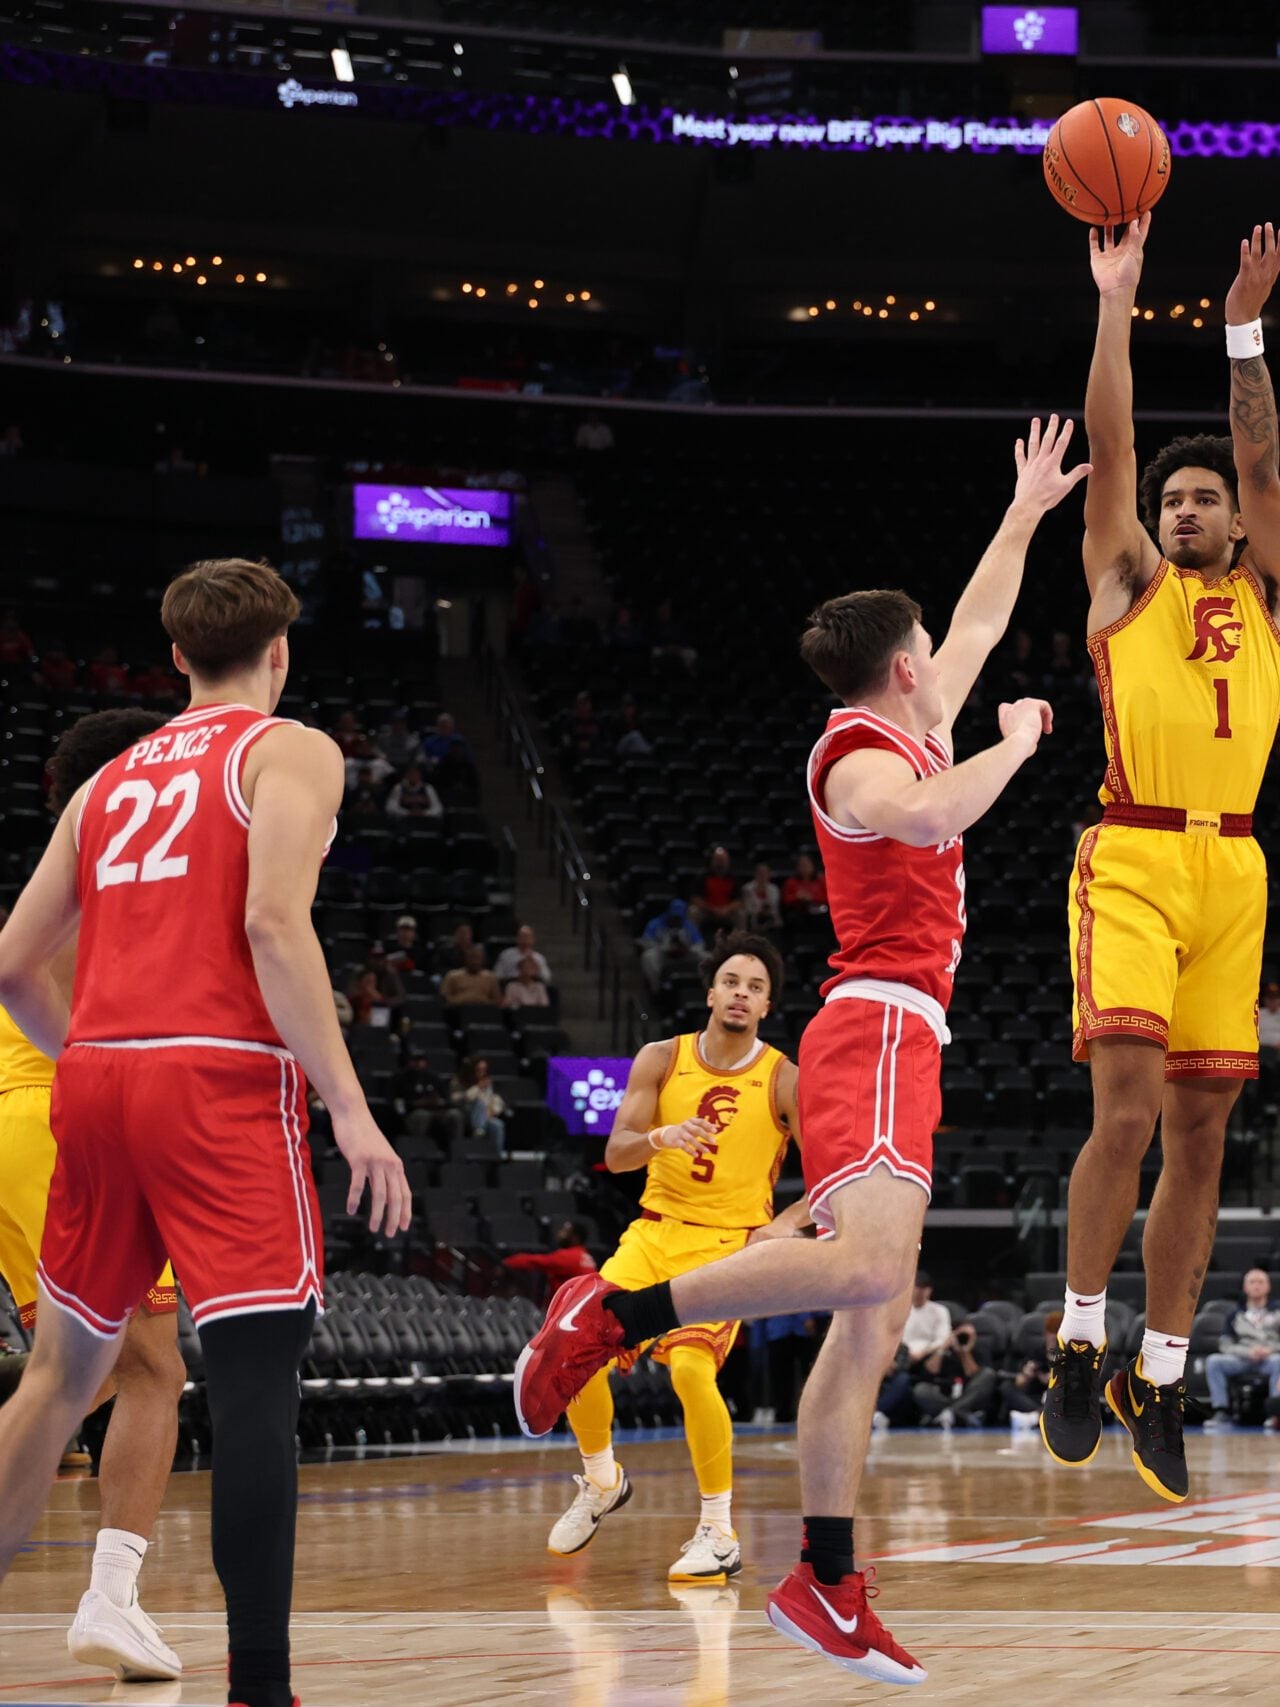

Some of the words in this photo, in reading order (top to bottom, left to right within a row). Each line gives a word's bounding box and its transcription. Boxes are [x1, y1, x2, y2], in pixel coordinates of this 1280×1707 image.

[672, 113, 726, 140] Meet
[727, 123, 778, 145] your
[779, 124, 826, 142] new
[827, 120, 873, 145] BFF,
[874, 125, 925, 147] your
[926, 121, 963, 149] Big
[963, 122, 1050, 146] Financia
[389, 505, 491, 532] experian
[1212, 678, 1233, 739] 1
[124, 724, 227, 772] PENCE
[96, 769, 201, 891] 22
[1189, 819, 1208, 827] FIGHT
[691, 1142, 719, 1184] 5
